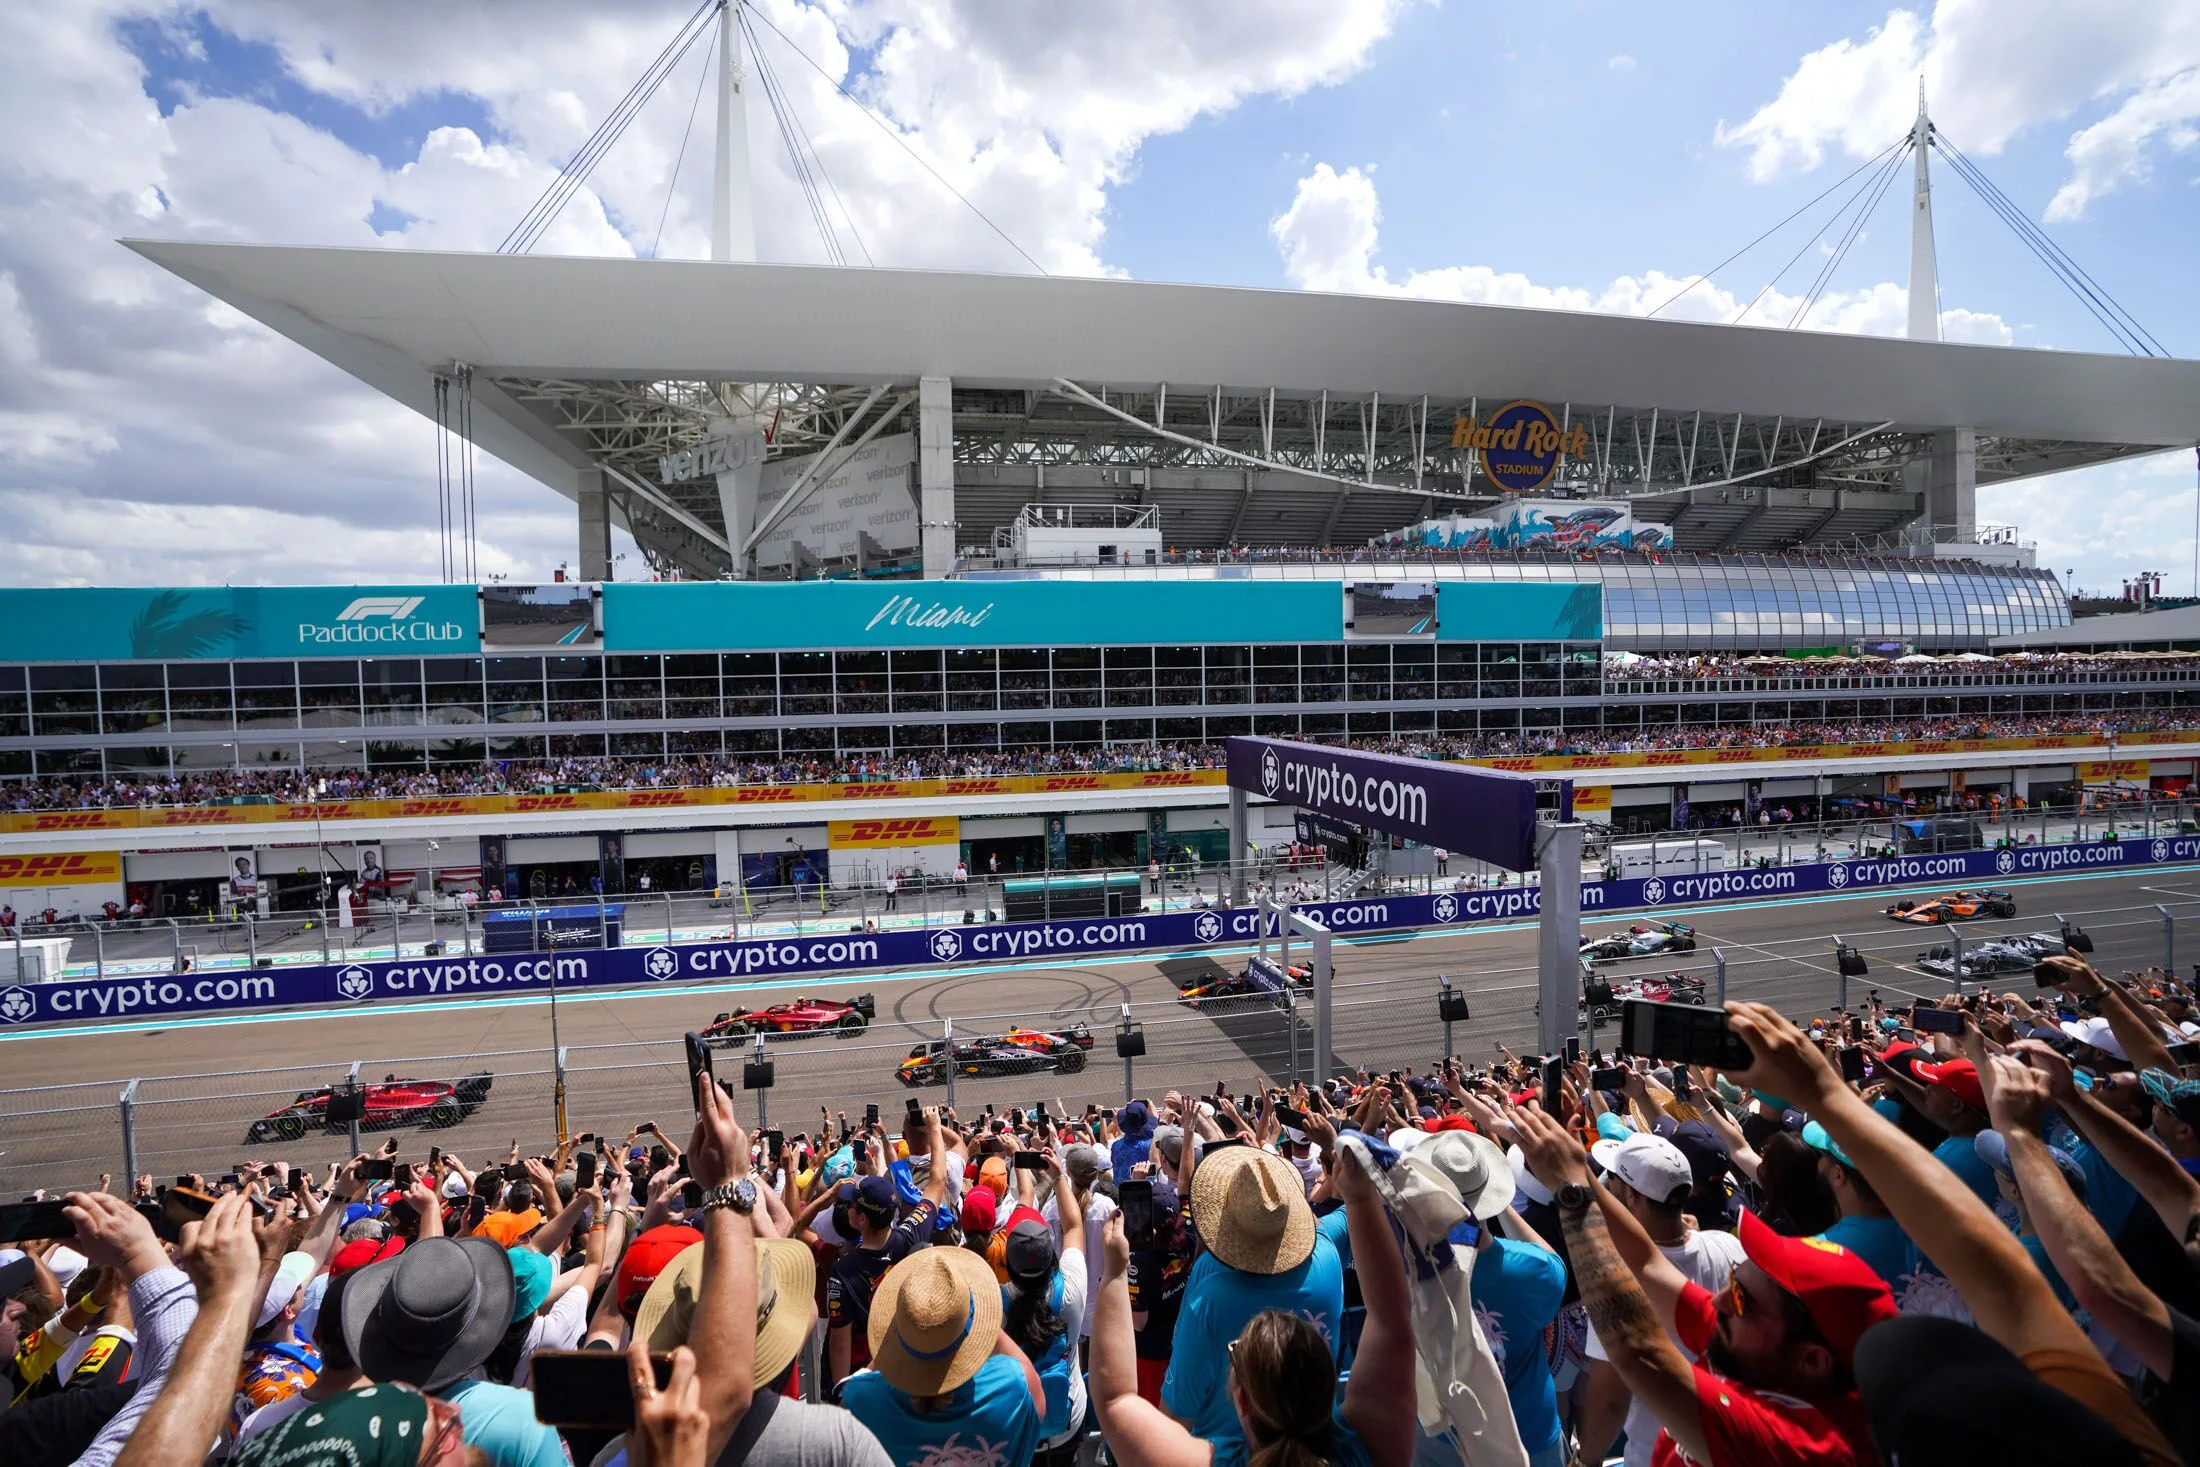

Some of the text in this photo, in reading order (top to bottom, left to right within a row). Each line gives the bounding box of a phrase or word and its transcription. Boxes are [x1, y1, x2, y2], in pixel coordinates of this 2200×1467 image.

[1452, 415, 1588, 461] Hard Rock
[658, 434, 767, 484] verizon
[1495, 463, 1544, 475] STADIUM
[837, 493, 879, 509] verizon
[867, 510, 910, 527] verizon
[809, 519, 849, 535] verizon
[864, 594, 995, 632] Miami
[299, 621, 463, 643] Paddock Club
[1914, 743, 1949, 753] DHL
[2034, 737, 2067, 748] DHL
[1717, 751, 1754, 761] DHL
[1785, 748, 1821, 759] DHL
[1850, 745, 1885, 756] DHL
[1491, 759, 1534, 771] DHL
[1571, 757, 1612, 768] DHL
[1646, 753, 1685, 765] DHL
[2090, 761, 2139, 777] DHL
[1046, 777, 1100, 790] DHL
[1142, 773, 1194, 785] DHL
[737, 788, 795, 801] DHL
[844, 784, 900, 798] DHL
[946, 781, 1001, 794] DHL
[1284, 762, 1427, 826] crypto.com
[516, 796, 577, 811] DHL
[628, 791, 688, 806] DHL
[288, 805, 353, 820] DHL
[401, 801, 464, 815] DHL
[36, 814, 107, 829] DHL
[165, 809, 232, 824] DHL
[850, 819, 938, 840] DHL
[2020, 845, 2124, 869] crypto.com
[1855, 857, 1966, 883] crypto.com
[1672, 871, 1796, 898] crypto.com
[1466, 886, 1604, 917] cryptom
[972, 922, 1146, 955] crypto.com
[689, 940, 878, 973] crypto.com
[385, 958, 588, 992] crypto.com
[50, 976, 275, 1014] crypto.com
